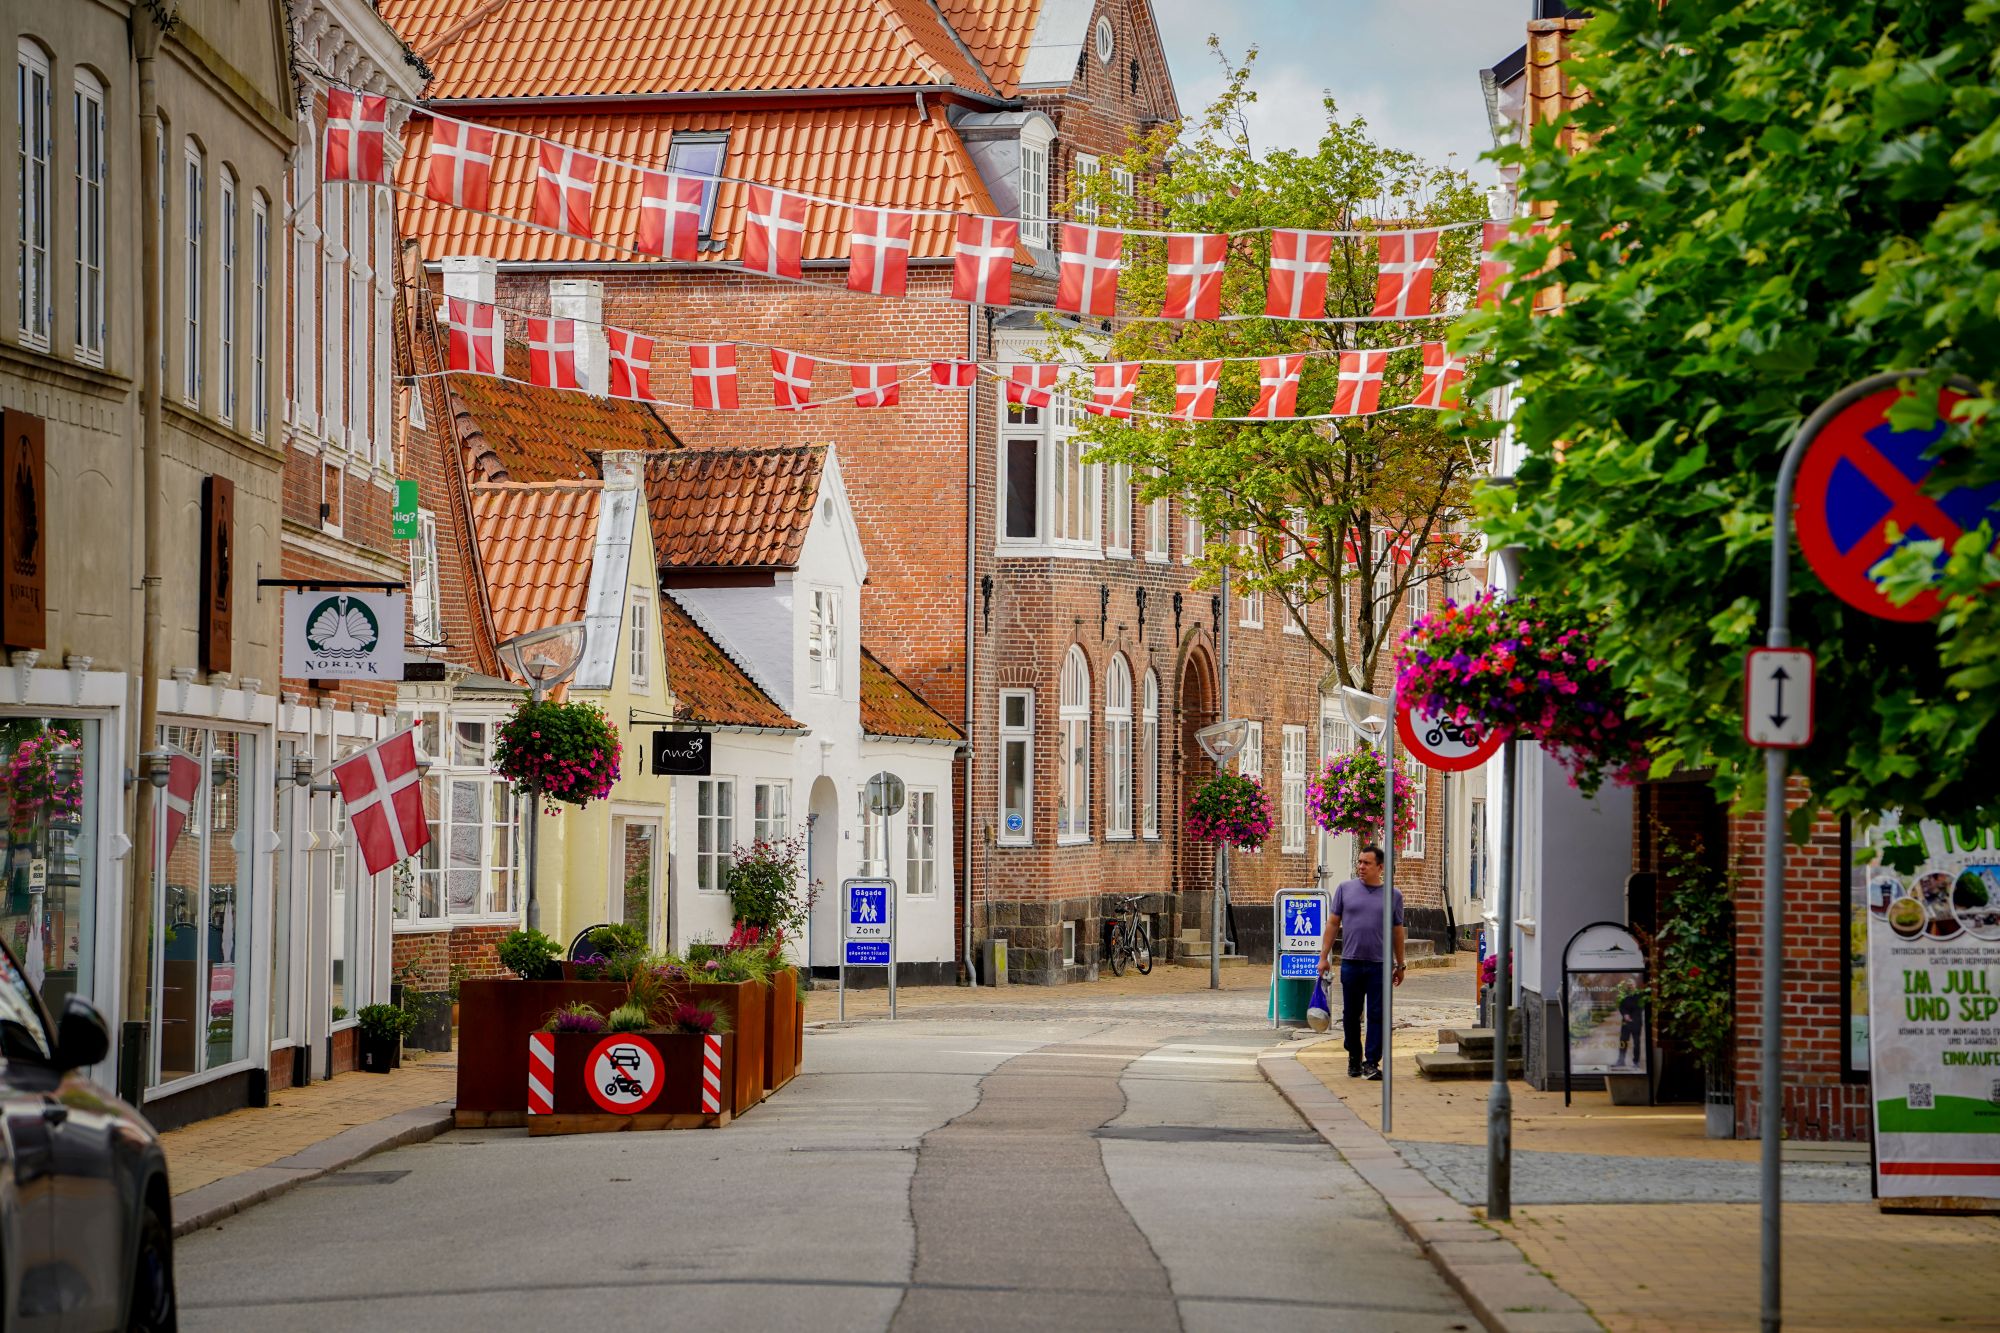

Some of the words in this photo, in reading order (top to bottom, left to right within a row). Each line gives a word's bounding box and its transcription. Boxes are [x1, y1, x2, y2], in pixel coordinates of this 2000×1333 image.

[304, 660, 378, 674] NORLYK
[855, 889, 882, 897] Gågade
[1903, 969, 1932, 994] IM
[1905, 996, 1950, 1022] UND
